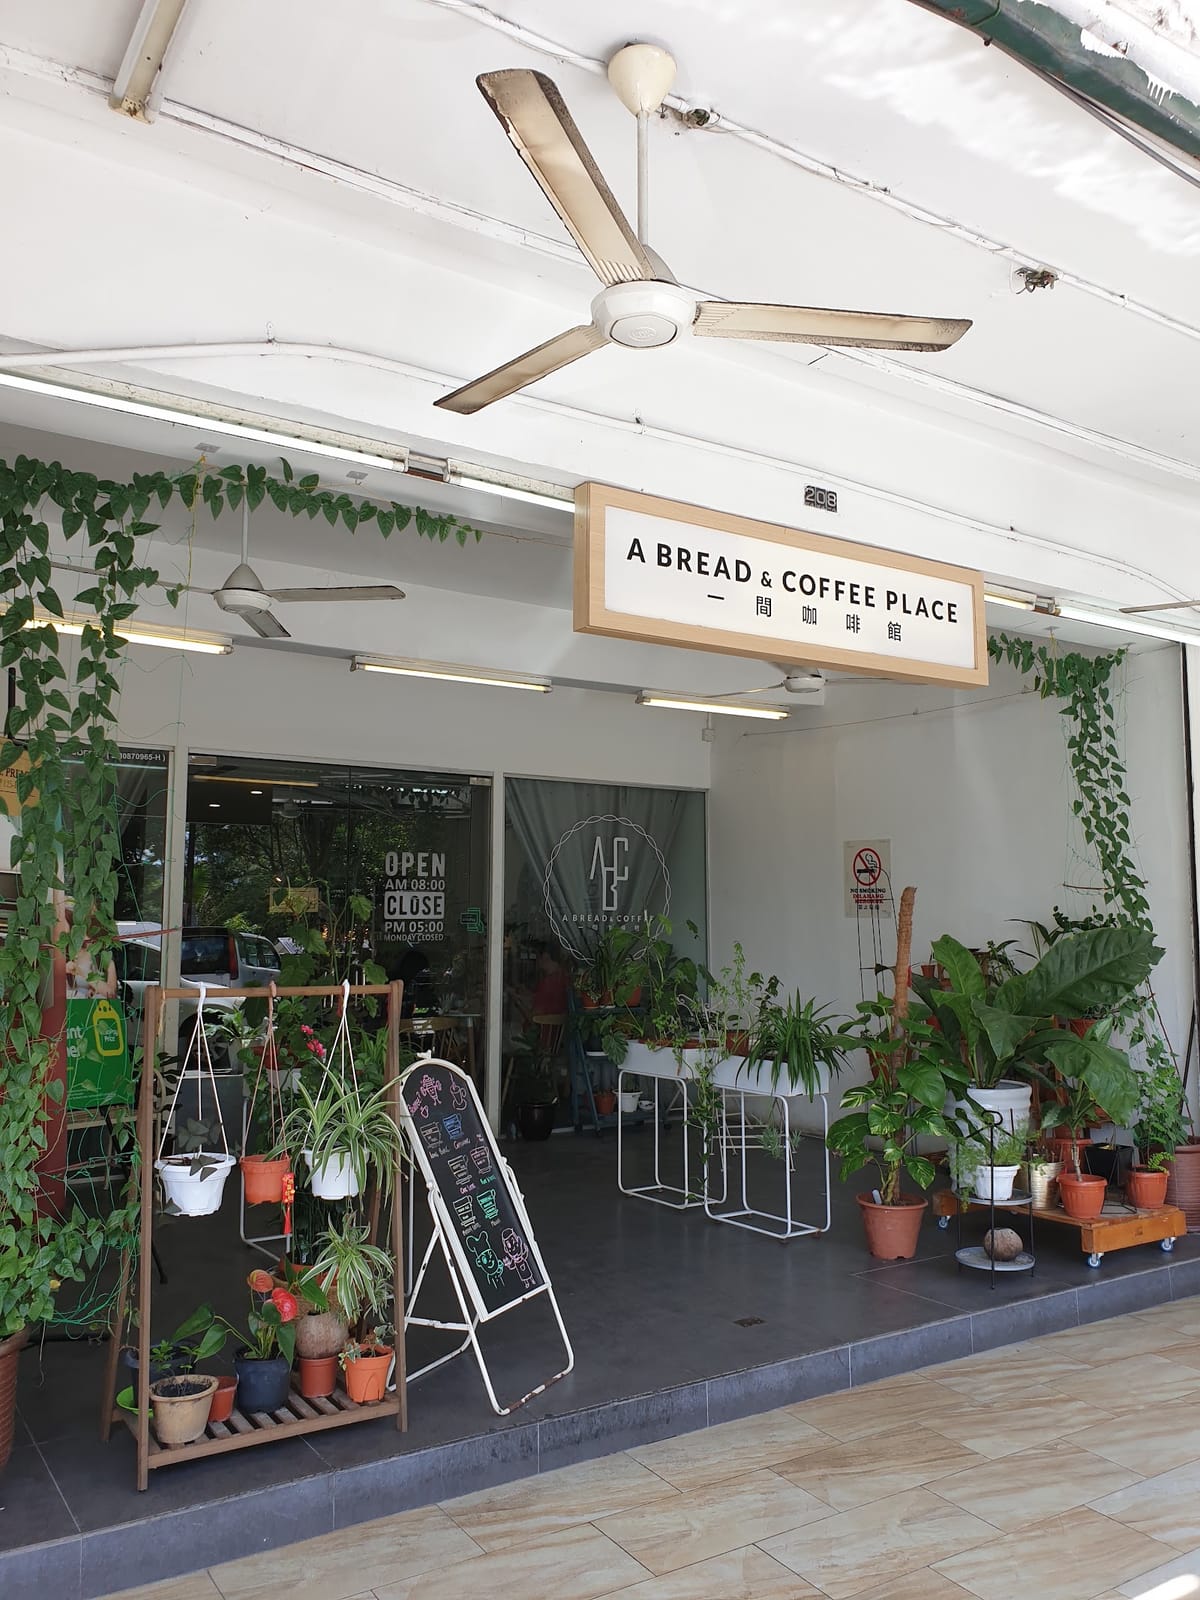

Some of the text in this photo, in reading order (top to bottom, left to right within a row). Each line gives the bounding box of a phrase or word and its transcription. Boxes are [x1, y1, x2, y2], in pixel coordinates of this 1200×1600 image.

[805, 486, 836, 507] 208
[627, 538, 958, 623] A BREAD & COFFEE PLACE
[707, 594, 902, 642] 一間咖啡館
[385, 852, 446, 877] OPEN
[385, 879, 445, 890] AM 08:00
[387, 895, 443, 916] CLOSE
[384, 921, 444, 932] PM 05:00
[562, 914, 568, 922] A
[572, 914, 608, 922] BREAD
[384, 933, 416, 942] MONDAY
